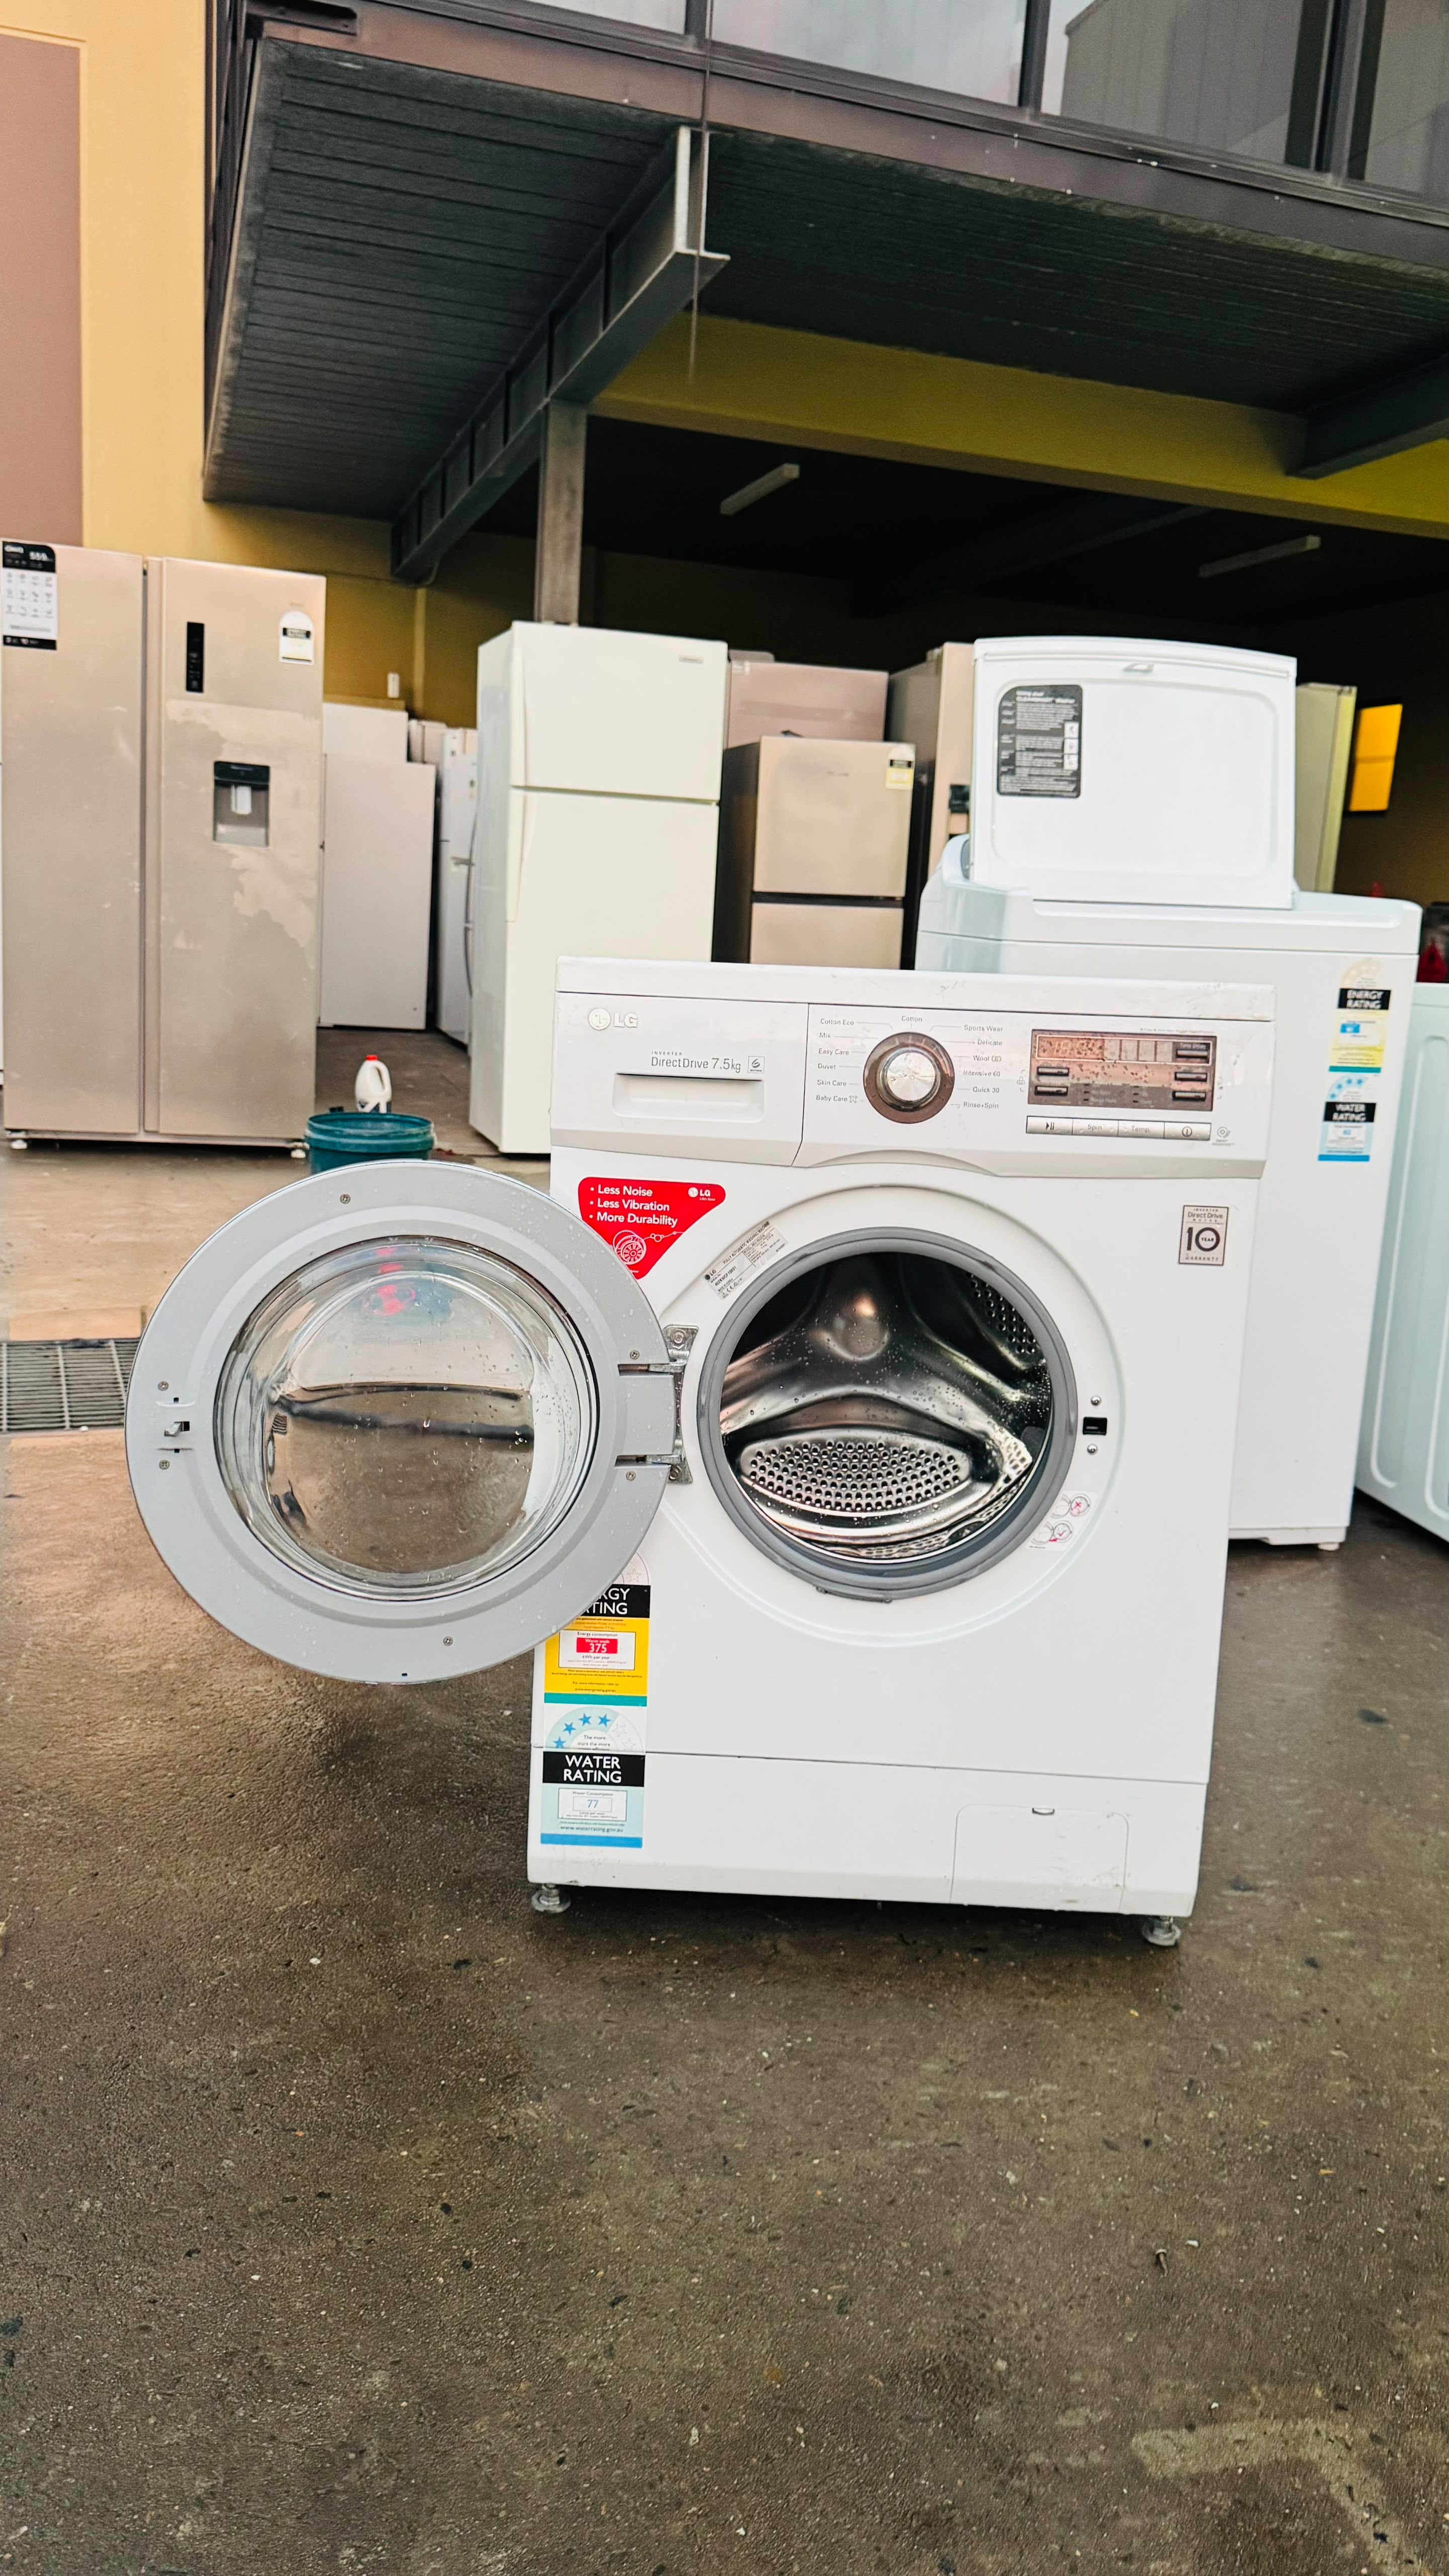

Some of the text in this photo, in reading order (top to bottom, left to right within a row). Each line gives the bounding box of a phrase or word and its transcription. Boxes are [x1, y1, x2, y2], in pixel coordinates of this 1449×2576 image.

[1346, 990, 1384, 999] ENERGY
[1346, 1000, 1381, 1009] RATING
[613, 1013, 638, 1027] LG
[1335, 1104, 1365, 1112] WATER
[1332, 1112, 1366, 1121] RATING
[598, 1184, 653, 1197] Less Noise
[597, 1198, 670, 1212] Less Vibration
[597, 1212, 678, 1228] More Durability
[1187, 1227, 1220, 1252] 10
[586, 1602, 627, 1615] TING
[589, 1644, 607, 1653] 375
[565, 1755, 621, 1769] WATER
[564, 1769, 621, 1783] RATING
[587, 1800, 599, 1808] 77
